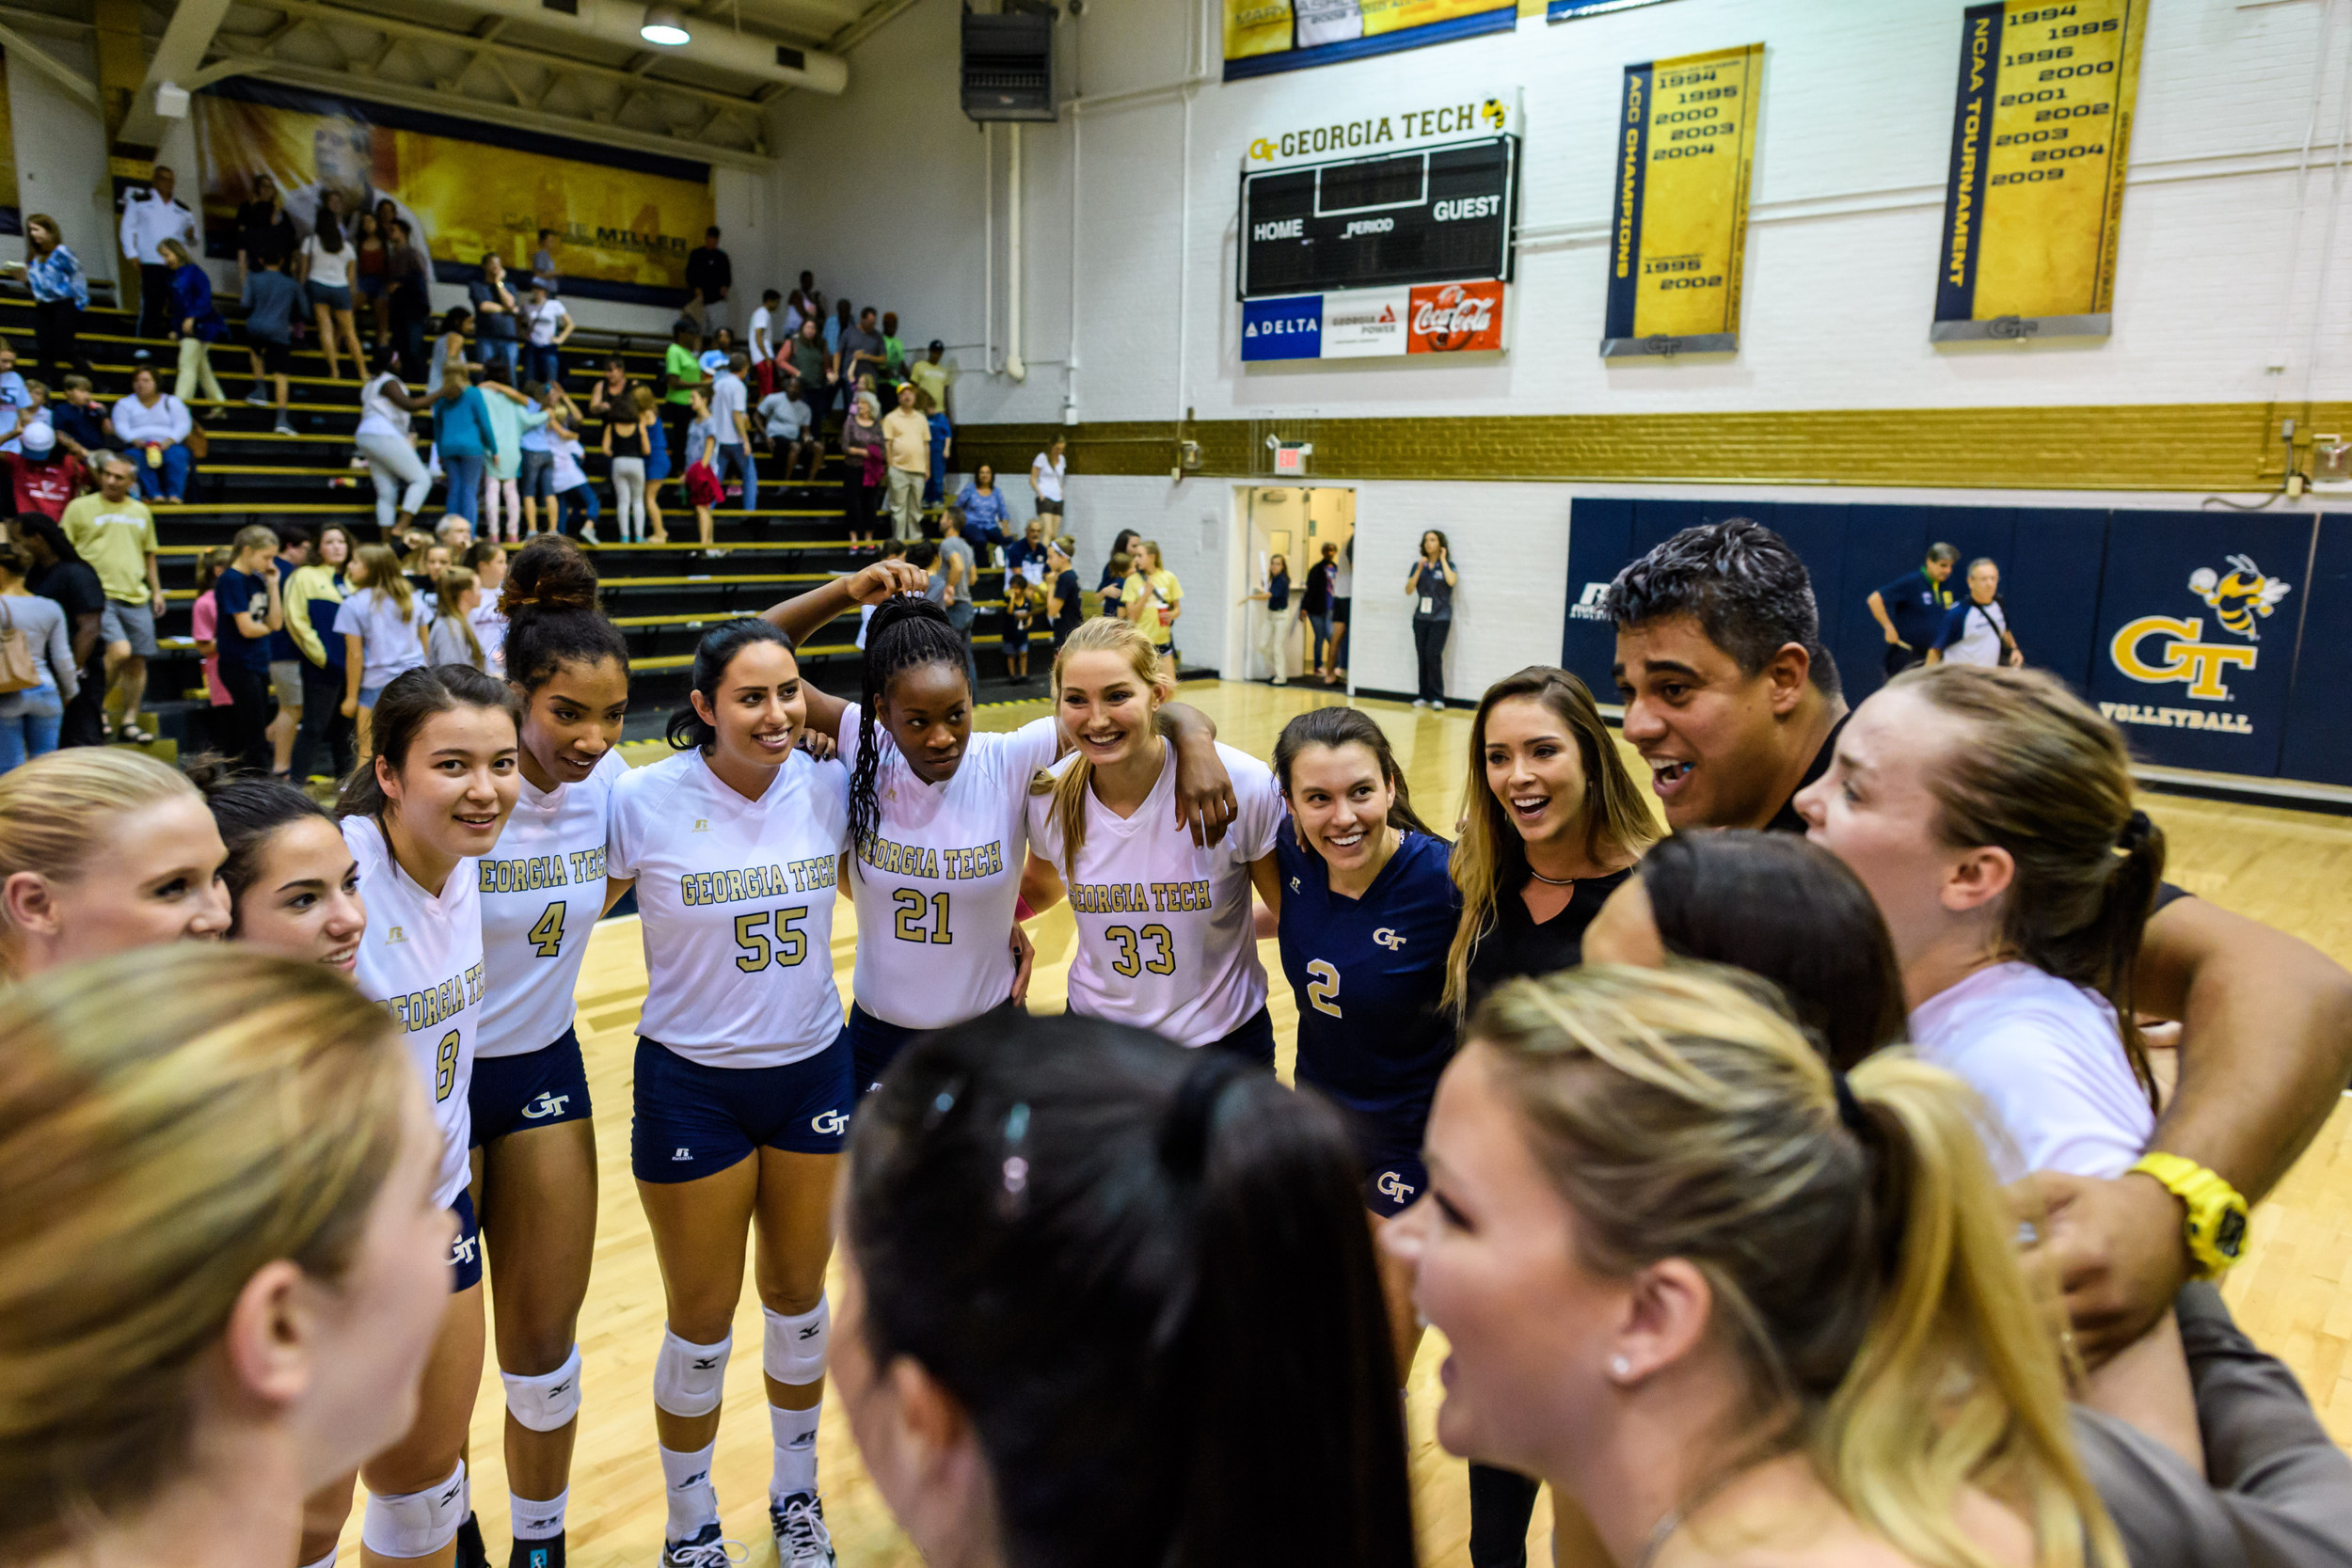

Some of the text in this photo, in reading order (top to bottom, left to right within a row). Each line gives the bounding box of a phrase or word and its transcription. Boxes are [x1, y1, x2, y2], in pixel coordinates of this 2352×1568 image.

[2009, 5, 2077, 26] 1994
[2047, 18, 2119, 40] 1995
[2004, 46, 2074, 67] 1996
[1659, 71, 1716, 89] 1994
[2039, 61, 2114, 82] 2000
[1678, 86, 1738, 103] 1995
[2000, 88, 2068, 106] 2001
[1655, 106, 1718, 125] 2000
[2035, 103, 2110, 122] 2002
[1249, 103, 1474, 161] GT GEORGIA TECH
[1671, 122, 1734, 141] 2003
[1995, 128, 2069, 147] 2003
[1653, 144, 1715, 161] 2004
[1949, 18, 1991, 287] NCAA TOURNAMENT
[2030, 144, 2106, 163] 2004
[1617, 75, 1643, 278] ACC CHAMPIONS
[1992, 168, 2065, 186] 2009
[1433, 195, 1501, 221] GUEST
[1254, 219, 1303, 241] HOME
[1347, 218, 1394, 235] PERIOD
[1645, 260, 1701, 274] 1995
[1661, 276, 1723, 291] 2002
[1262, 318, 1317, 335] DELTA
[2110, 615, 2258, 701] GT
[2099, 702, 2253, 735] VOLLEYBALL
[479, 844, 607, 894] EORGIA TEC
[944, 839, 1003, 880] TECH
[681, 854, 836, 906] GEORGIA TECH
[1151, 880, 1212, 911] TECH
[892, 887, 953, 944] 21
[528, 900, 566, 958] 4
[734, 905, 808, 974] 55
[1373, 927, 1406, 952] GT
[1104, 924, 1176, 978] 33
[1306, 958, 1343, 1019] 2
[436, 1028, 460, 1104] 8
[521, 1091, 569, 1118] GT
[811, 1110, 850, 1135] GT
[1377, 1171, 1415, 1204] GT
